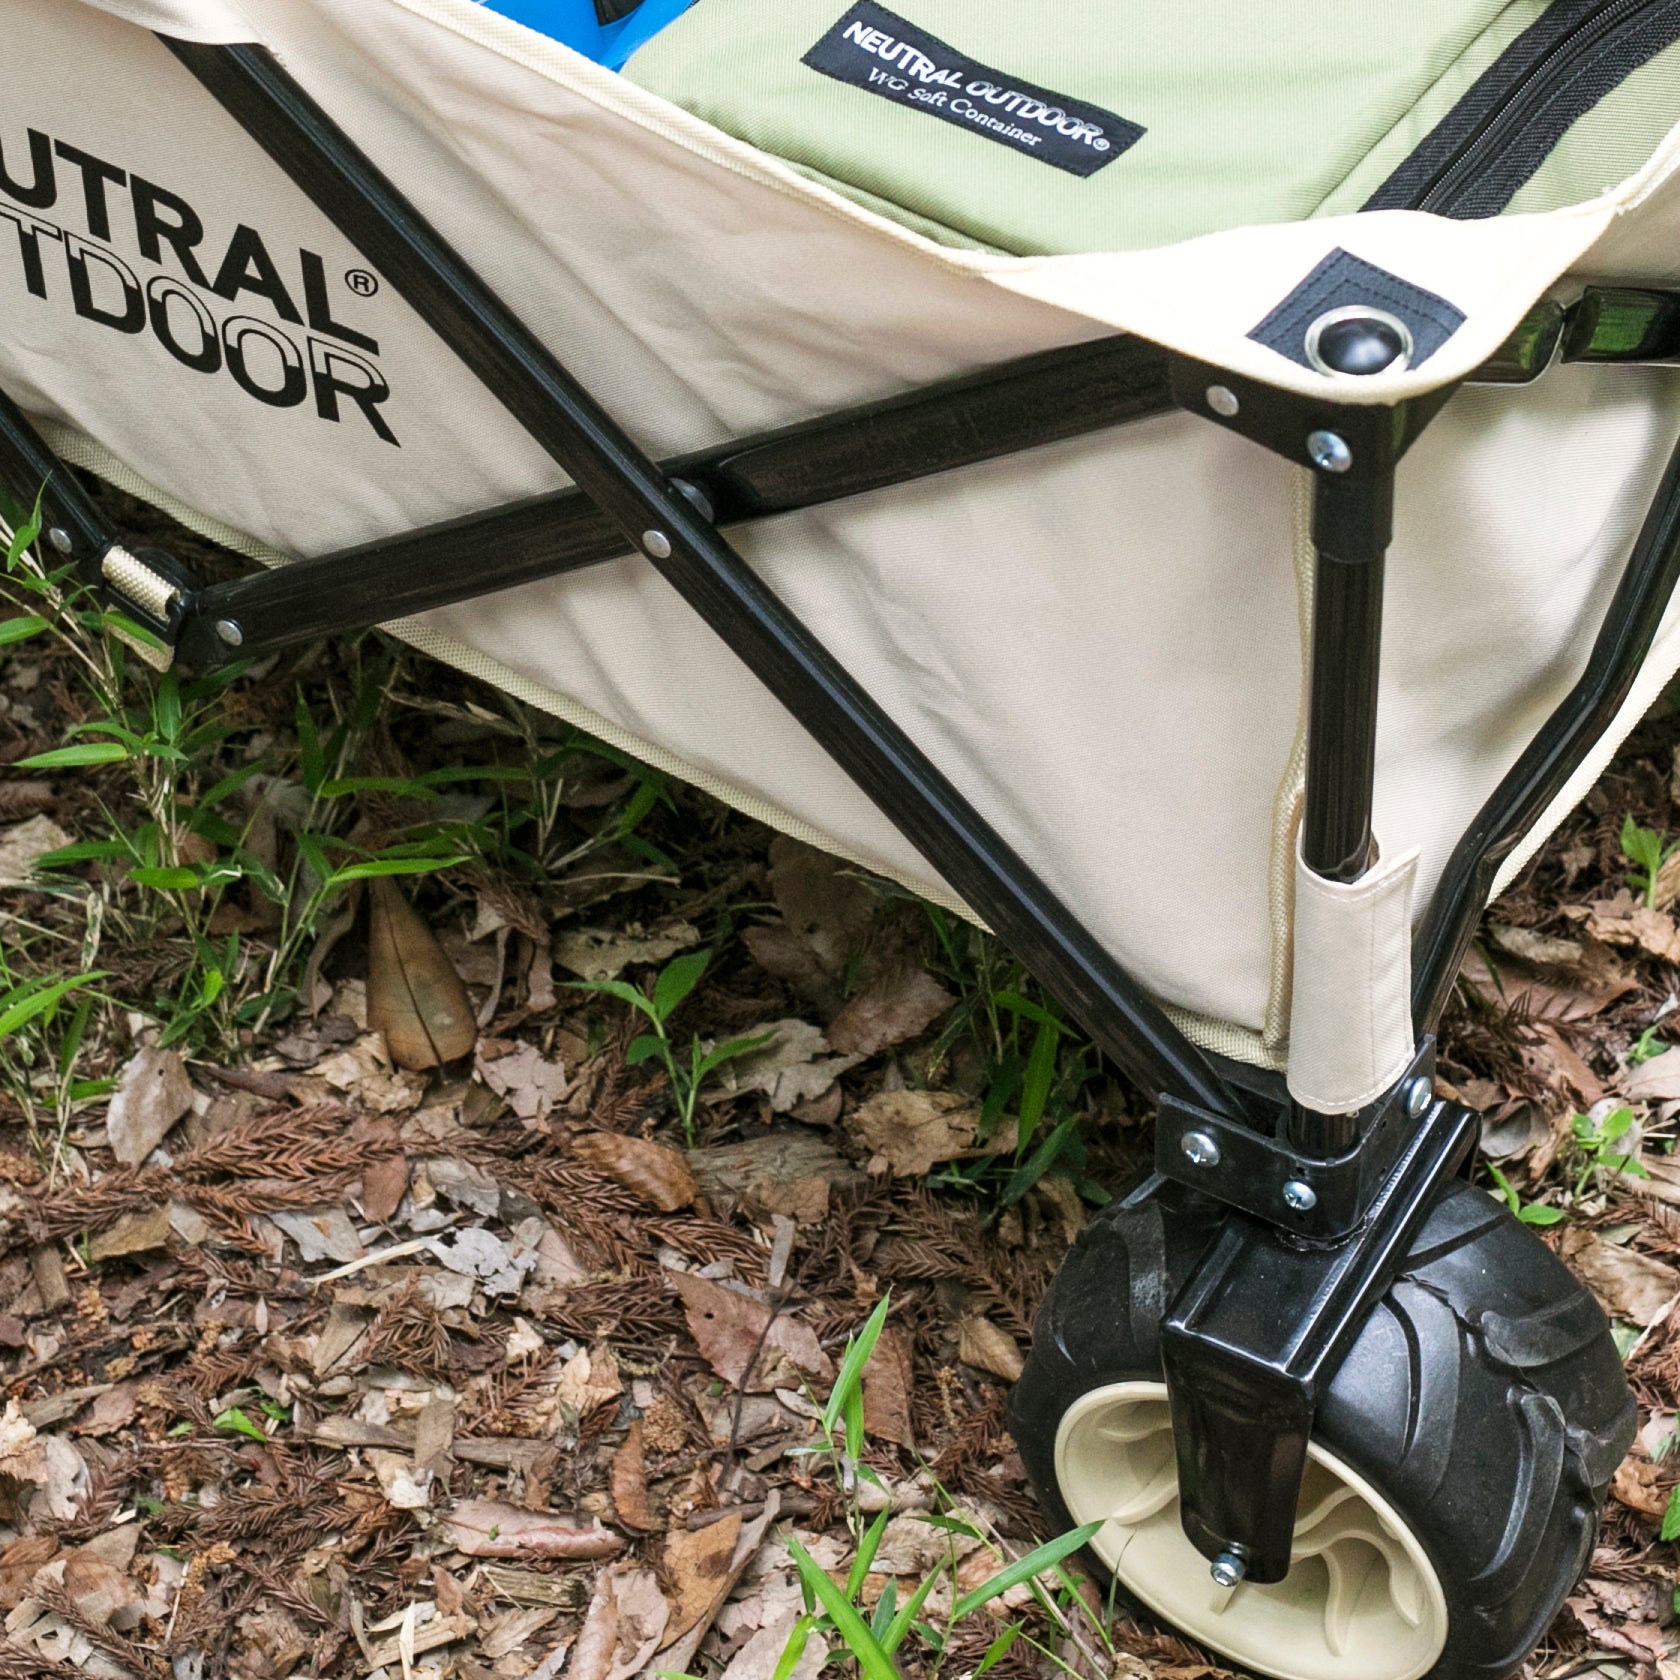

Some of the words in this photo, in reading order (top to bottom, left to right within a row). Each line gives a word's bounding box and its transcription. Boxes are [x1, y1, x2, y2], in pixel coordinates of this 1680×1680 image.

[842, 21, 963, 89] NEUTRAL
[868, 67, 909, 92] WG
[907, 87, 948, 109] Soft
[949, 98, 1042, 147] Container
